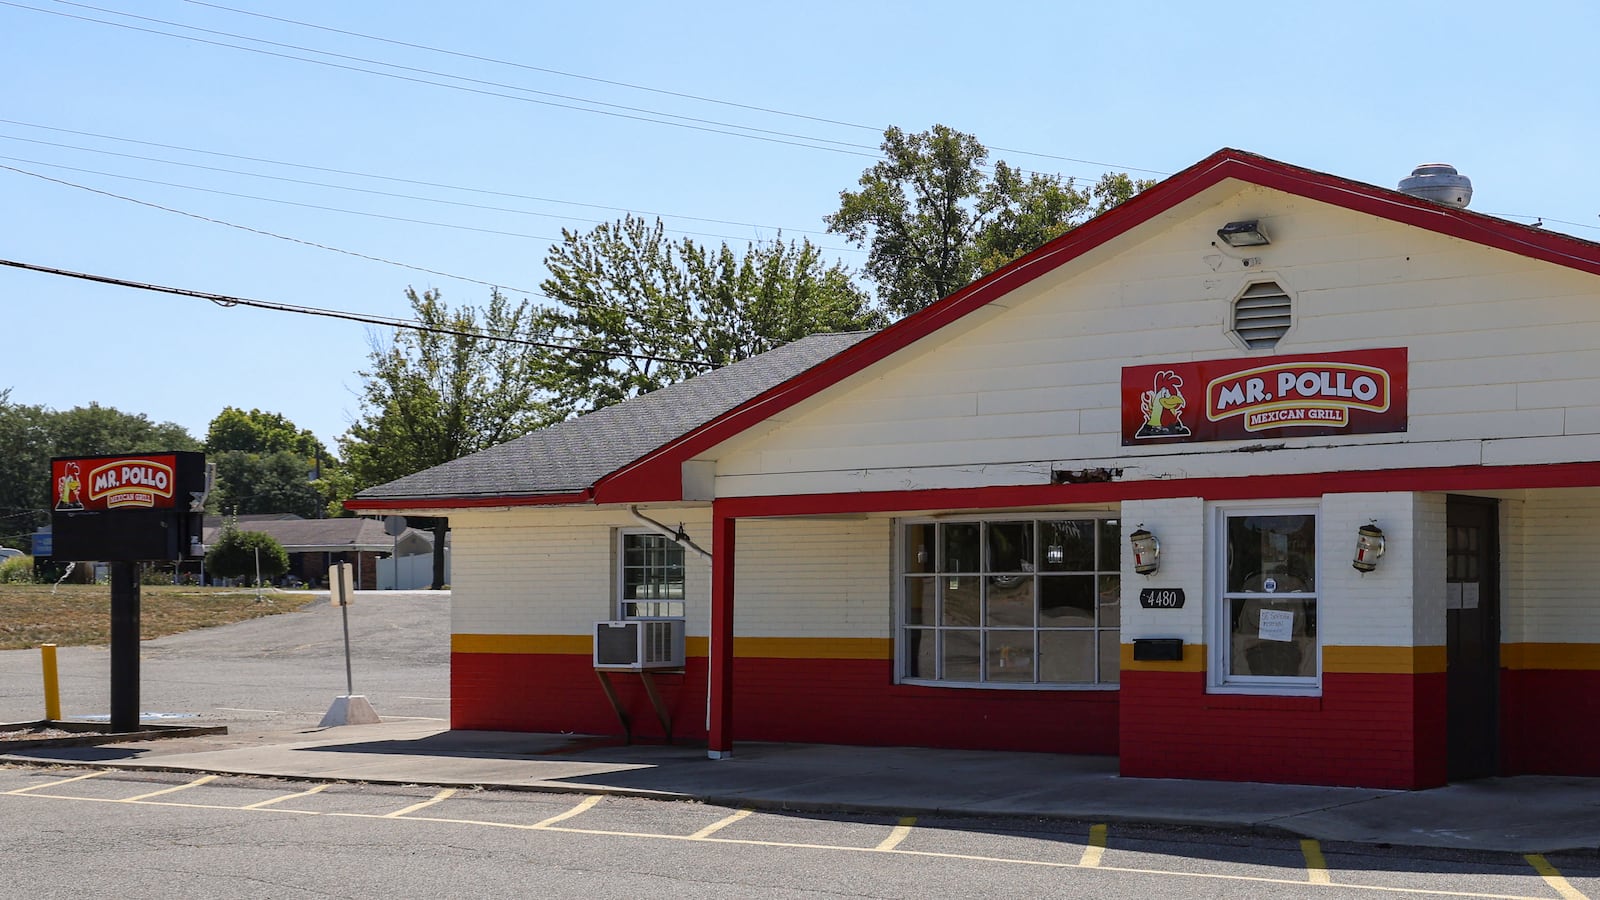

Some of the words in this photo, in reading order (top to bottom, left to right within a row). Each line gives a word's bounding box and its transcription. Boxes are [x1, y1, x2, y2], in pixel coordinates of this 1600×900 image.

[1217, 377, 1272, 409] MR.
[1277, 371, 1378, 401] POLLO
[1250, 409, 1305, 425] MEXICAN
[1308, 408, 1343, 421] GRILL
[95, 470, 119, 491] MR.
[122, 467, 167, 489] POLLO
[110, 493, 134, 503] MEXICAN
[1148, 590, 1177, 607] 4480
